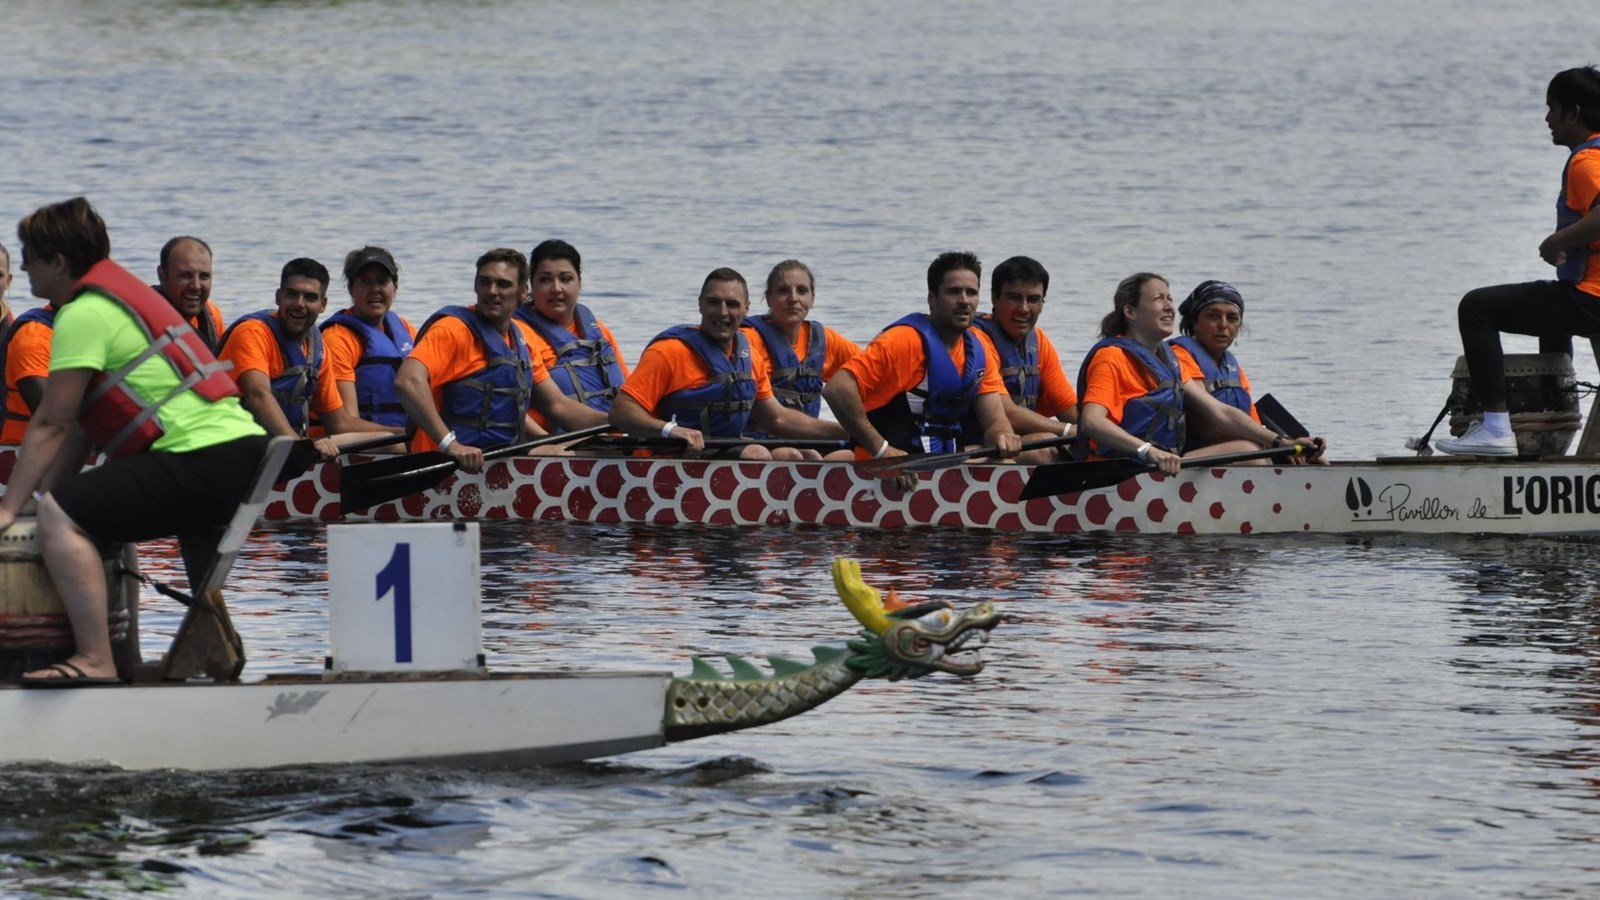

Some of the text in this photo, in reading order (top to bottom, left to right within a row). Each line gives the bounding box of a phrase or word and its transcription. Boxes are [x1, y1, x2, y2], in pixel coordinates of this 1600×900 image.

[1379, 474, 1600, 521] Pavillon de L'ORIG
[375, 542, 412, 663] 1
